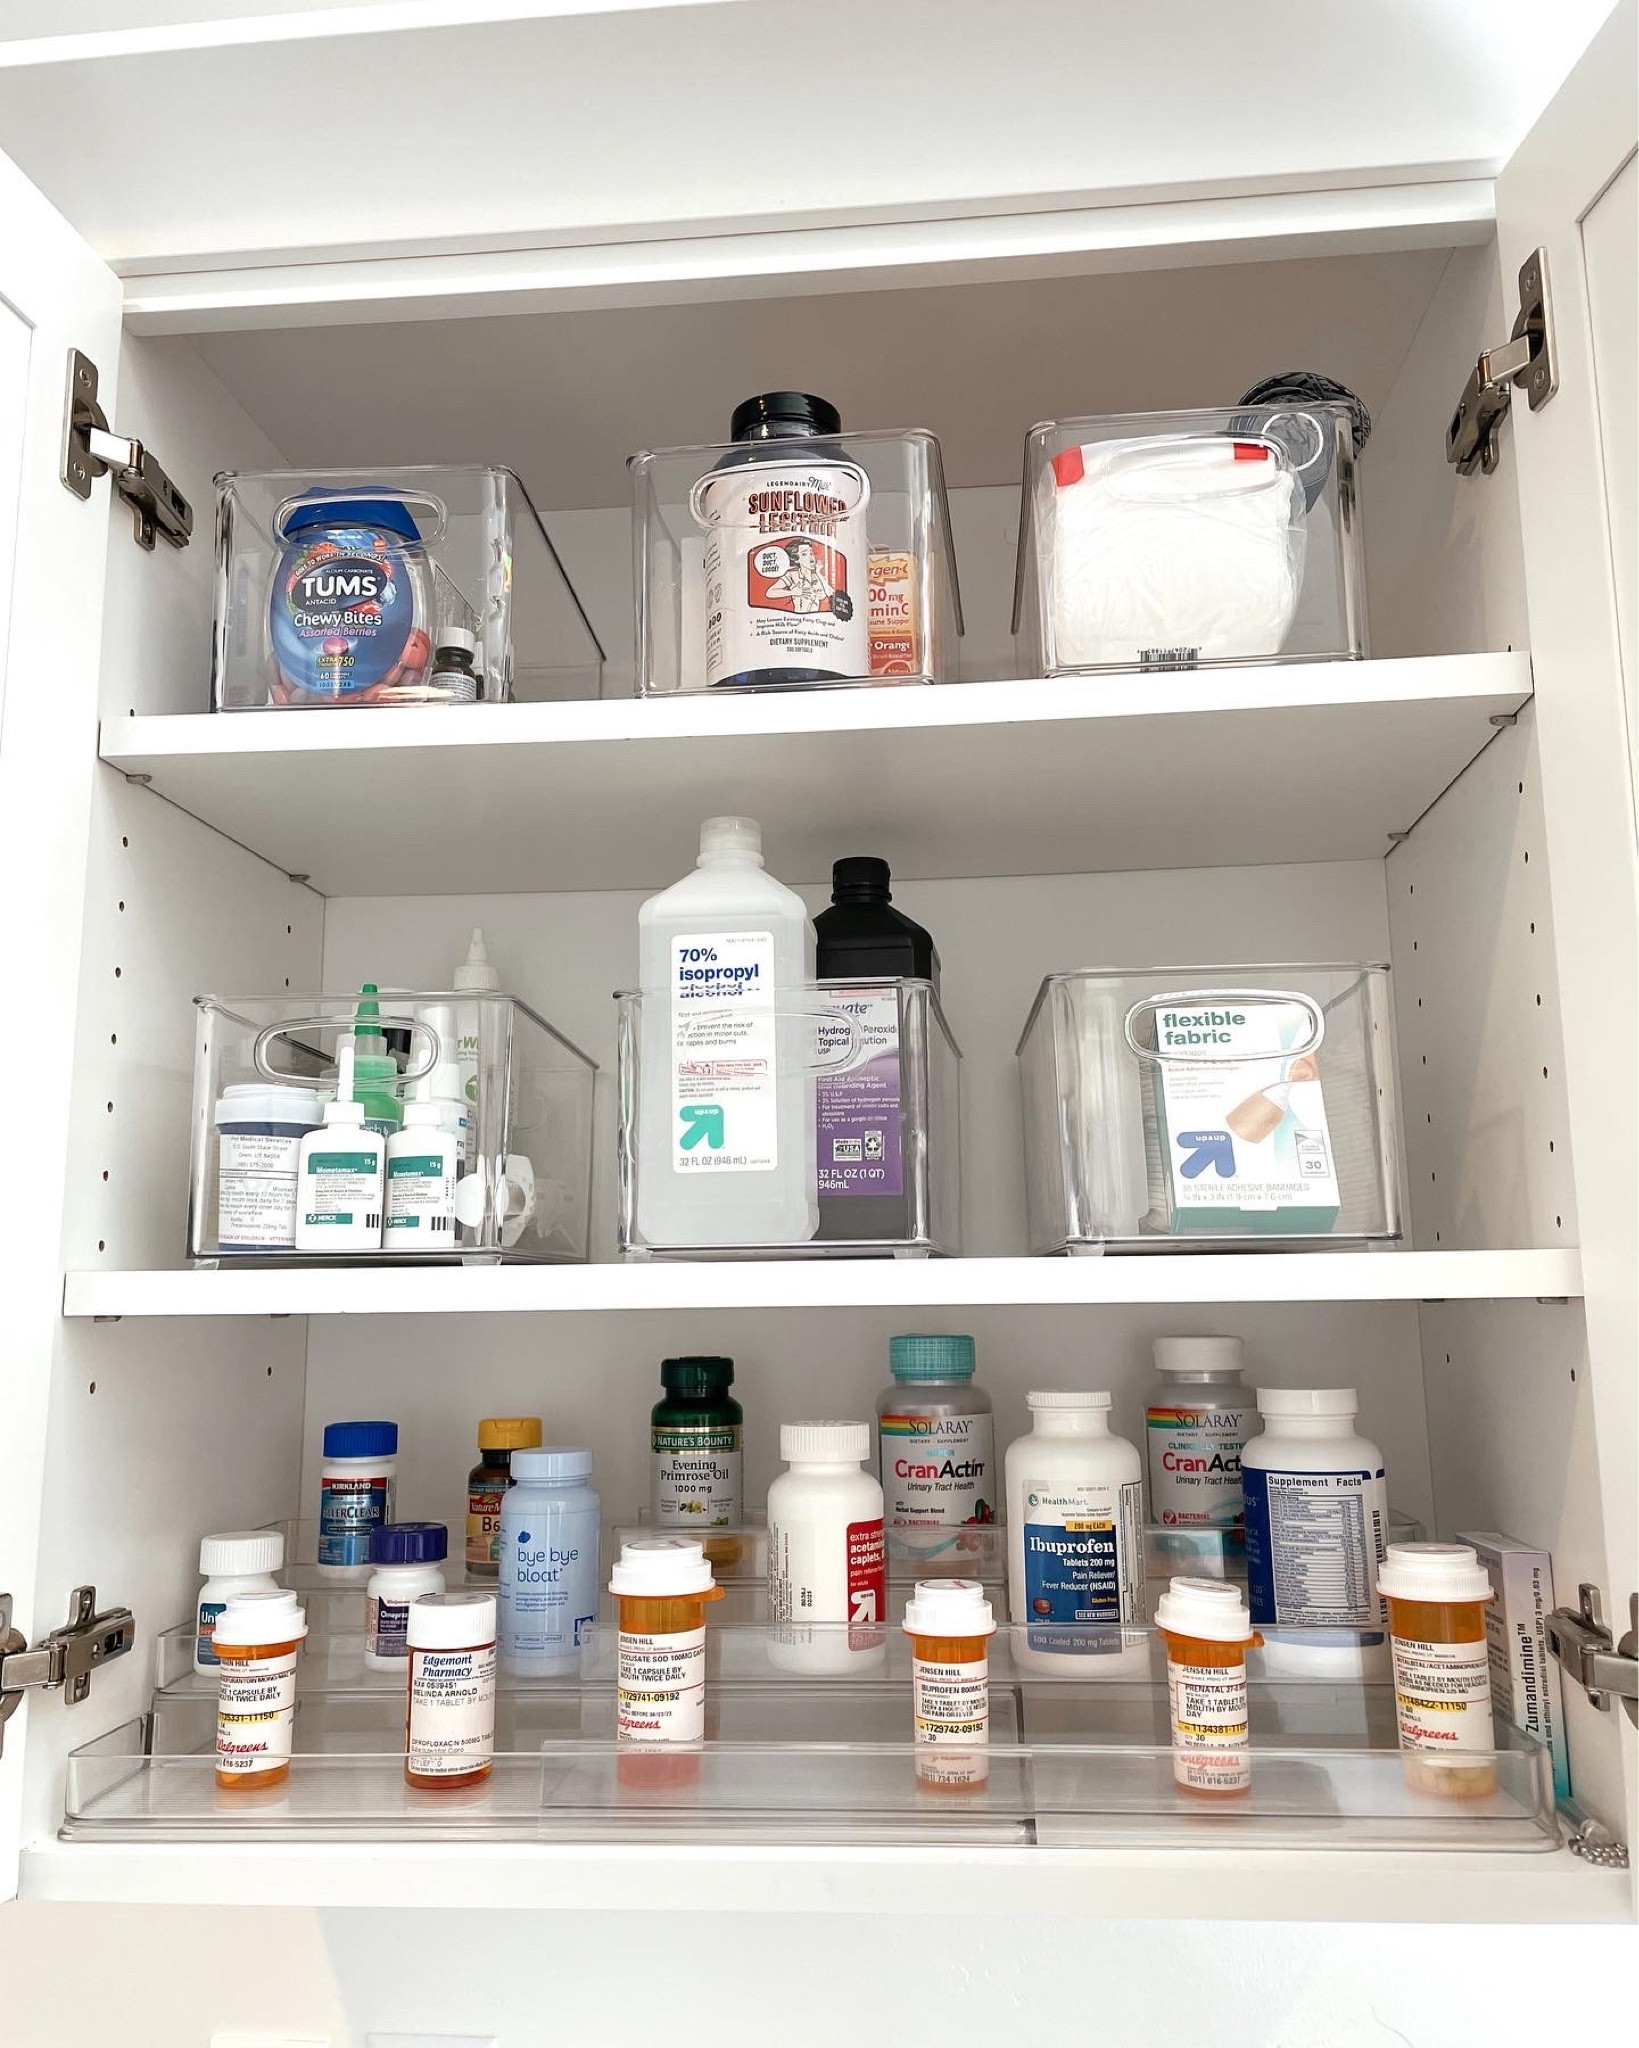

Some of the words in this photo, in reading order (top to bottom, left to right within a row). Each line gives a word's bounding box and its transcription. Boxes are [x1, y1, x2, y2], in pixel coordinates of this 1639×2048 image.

[301, 575, 378, 598] TUMS
[869, 604, 900, 616] min
[294, 611, 341, 628] Chewy
[344, 611, 383, 626] Bites
[300, 627, 340, 638] Assorted
[343, 627, 378, 637] Berries
[679, 947, 719, 963] 70%
[679, 963, 760, 983] isopropyl
[1163, 1011, 1246, 1028] flexible
[818, 1026, 851, 1038] Hydrog
[863, 1024, 897, 1035] Peroxid
[818, 1037, 850, 1047] Topical
[1165, 1031, 1232, 1046] fabric
[691, 1157, 701, 1166] FL
[1305, 1161, 1322, 1170] 30
[818, 1169, 829, 1179] 32
[831, 1169, 843, 1178] FL
[844, 1169, 858, 1179] OZ
[818, 1179, 850, 1190] 946mL
[1176, 1411, 1241, 1428] SOLARAY
[909, 1418, 971, 1435] SOLARAY
[657, 1435, 695, 1447] NATURE'S
[698, 1435, 733, 1447] BOUNTY
[1168, 1442, 1215, 1450] CLINICLY
[1218, 1442, 1244, 1450] TESTE
[672, 1460, 717, 1473] Evening
[1162, 1451, 1241, 1473] CranAct
[895, 1457, 985, 1479] CranActin
[660, 1469, 711, 1482] Primrose
[713, 1468, 730, 1480] Oil
[331, 1482, 372, 1491] KIRKLAND
[1175, 1475, 1201, 1487] Urinary
[1204, 1476, 1223, 1485] Tract
[1268, 1476, 1329, 1488] Supplement
[1336, 1477, 1362, 1487] Facts
[674, 1484, 696, 1493] 1000
[698, 1485, 713, 1494] mg
[907, 1481, 933, 1493] Urinary
[934, 1481, 953, 1492] Tract
[850, 1532, 870, 1543] extra
[850, 1540, 884, 1554] acetam
[1029, 1536, 1115, 1556] Ibuprofen
[517, 1546, 546, 1567] bye
[549, 1546, 579, 1566] bye
[1062, 1558, 1089, 1567] Tablets
[1089, 1558, 1104, 1566] 200
[1104, 1559, 1115, 1568] mg
[516, 1568, 560, 1583] bloat
[1072, 1570, 1088, 1580] Pain
[1041, 1580, 1060, 1590] Fever
[1060, 1582, 1089, 1591] Reducer
[1089, 1581, 1116, 1592] (NSAID)
[638, 1637, 654, 1645] HILL
[1087, 1639, 1099, 1648] mg
[1416, 1643, 1435, 1652] HILL
[422, 1653, 473, 1668] Edgemont
[652, 1655, 669, 1663] SOD
[422, 1665, 473, 1678] Pharmacy
[637, 1666, 671, 1675] CAPSULE
[919, 1666, 944, 1676] JENSEN
[1181, 1667, 1212, 1676] JENSEN
[1213, 1668, 1229, 1676] HILL
[641, 1673, 664, 1682] TWICE
[665, 1673, 687, 1681] DAILY
[232, 1688, 265, 1696] CAPSULE
[266, 1686, 278, 1694] BY
[444, 1687, 478, 1697] ARNOLD
[921, 1683, 960, 1694] IBUPROFEN
[1184, 1684, 1225, 1694] PRENATAL
[235, 1694, 258, 1702] TWICE
[259, 1691, 282, 1702] DAILY
[435, 1697, 465, 1707] TABLET
[1186, 1696, 1206, 1705] TAKE
[1186, 1703, 1215, 1713] MOUTH
[1216, 1705, 1227, 1713] BY
[1186, 1709, 1202, 1719] DAY
[927, 1733, 937, 1742] 30
[1400, 1723, 1459, 1741] Walgreens
